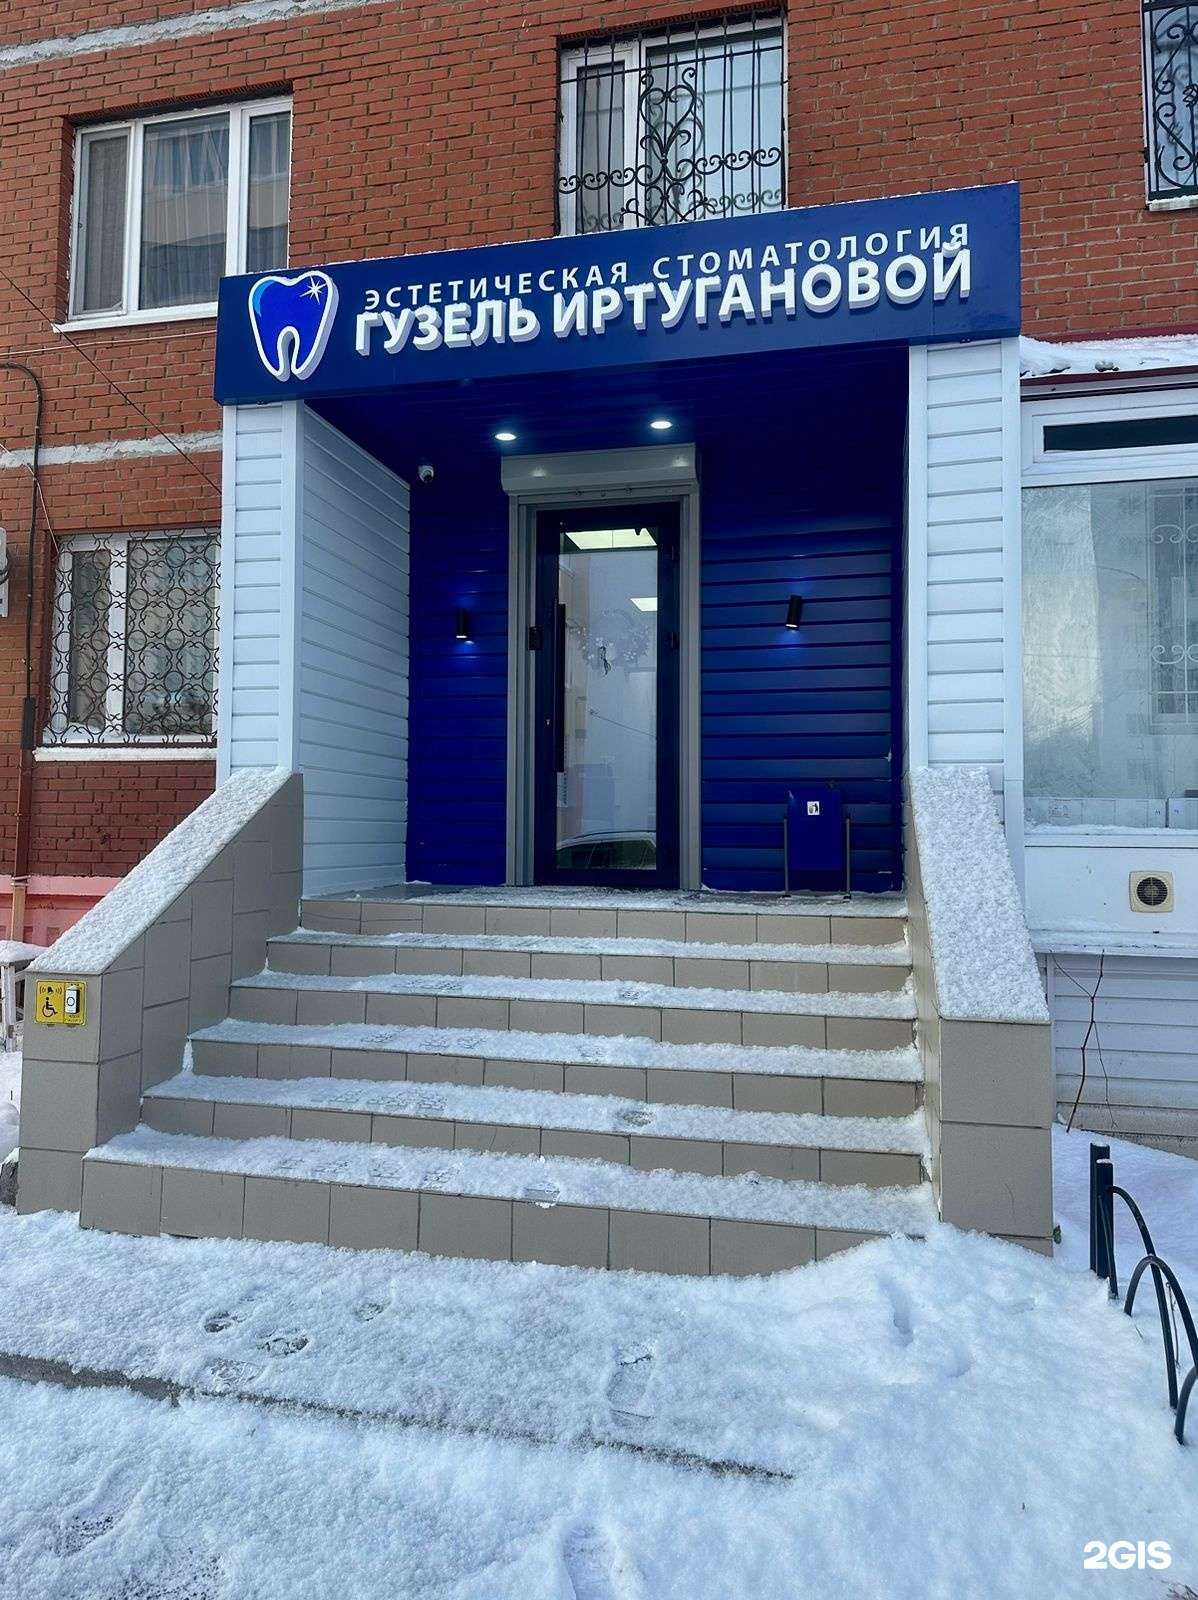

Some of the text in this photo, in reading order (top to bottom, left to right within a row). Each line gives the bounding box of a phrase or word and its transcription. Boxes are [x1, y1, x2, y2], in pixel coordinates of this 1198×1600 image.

[355, 242, 971, 356] ГУЗЕЛЬ ИРТУГАНОВОЙ
[364, 223, 969, 311] ЭСТЕТИЧЕСКАЯ СТОМАТОЛОГИЯ
